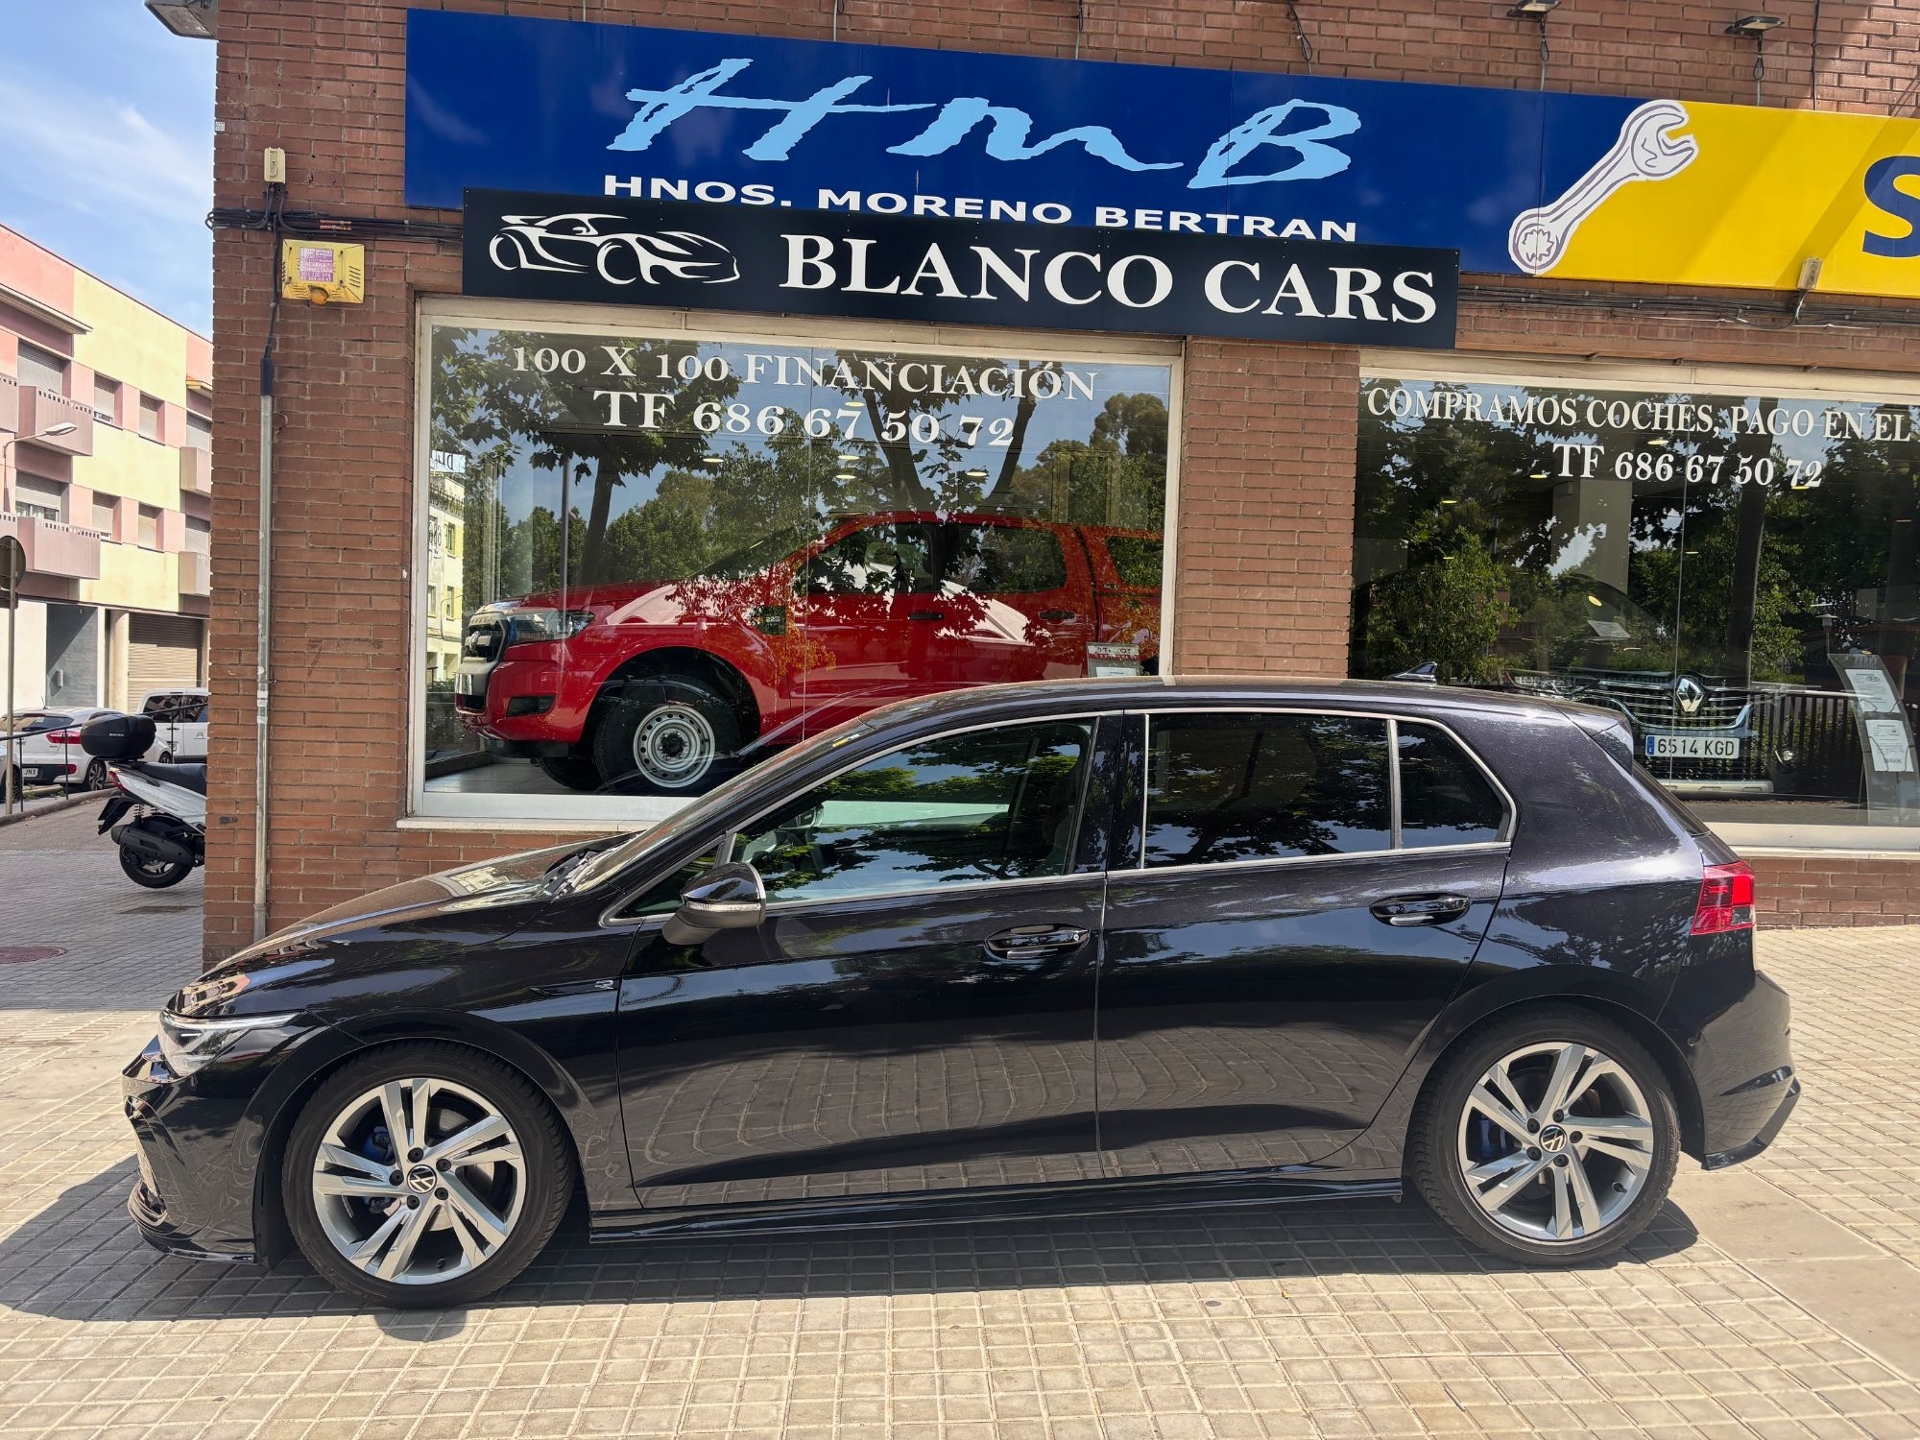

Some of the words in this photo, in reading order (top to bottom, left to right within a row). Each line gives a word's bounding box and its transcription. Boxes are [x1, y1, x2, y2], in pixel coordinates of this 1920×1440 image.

[605, 175, 791, 206] HNOS.
[819, 189, 1071, 223] MORENO
[1096, 207, 1355, 241] BERTRAN
[779, 235, 1172, 307] BLANCO
[1205, 261, 1436, 323] CARS
[512, 347, 586, 374] 100
[600, 345, 637, 377] X
[656, 353, 729, 381] 100
[743, 353, 1098, 401] FINANCIACIÓN
[593, 390, 675, 428] TF
[693, 402, 784, 435] 686
[803, 407, 861, 440] 67
[881, 410, 940, 443] 50
[959, 414, 1014, 446] 72
[1367, 387, 1577, 427] COMPRAMOS
[1587, 399, 1719, 437] COCHES,
[1730, 405, 1814, 437] PAGO
[1823, 410, 1865, 440] EN
[1874, 413, 1911, 442] EL
[1553, 443, 1604, 478] TF
[1615, 452, 1674, 482] 686
[1686, 455, 1724, 484] 67
[1735, 454, 1774, 486] 50
[1786, 459, 1822, 488] 72
[1657, 738, 1698, 755] 6514
[1704, 740, 1735, 756] KGD
